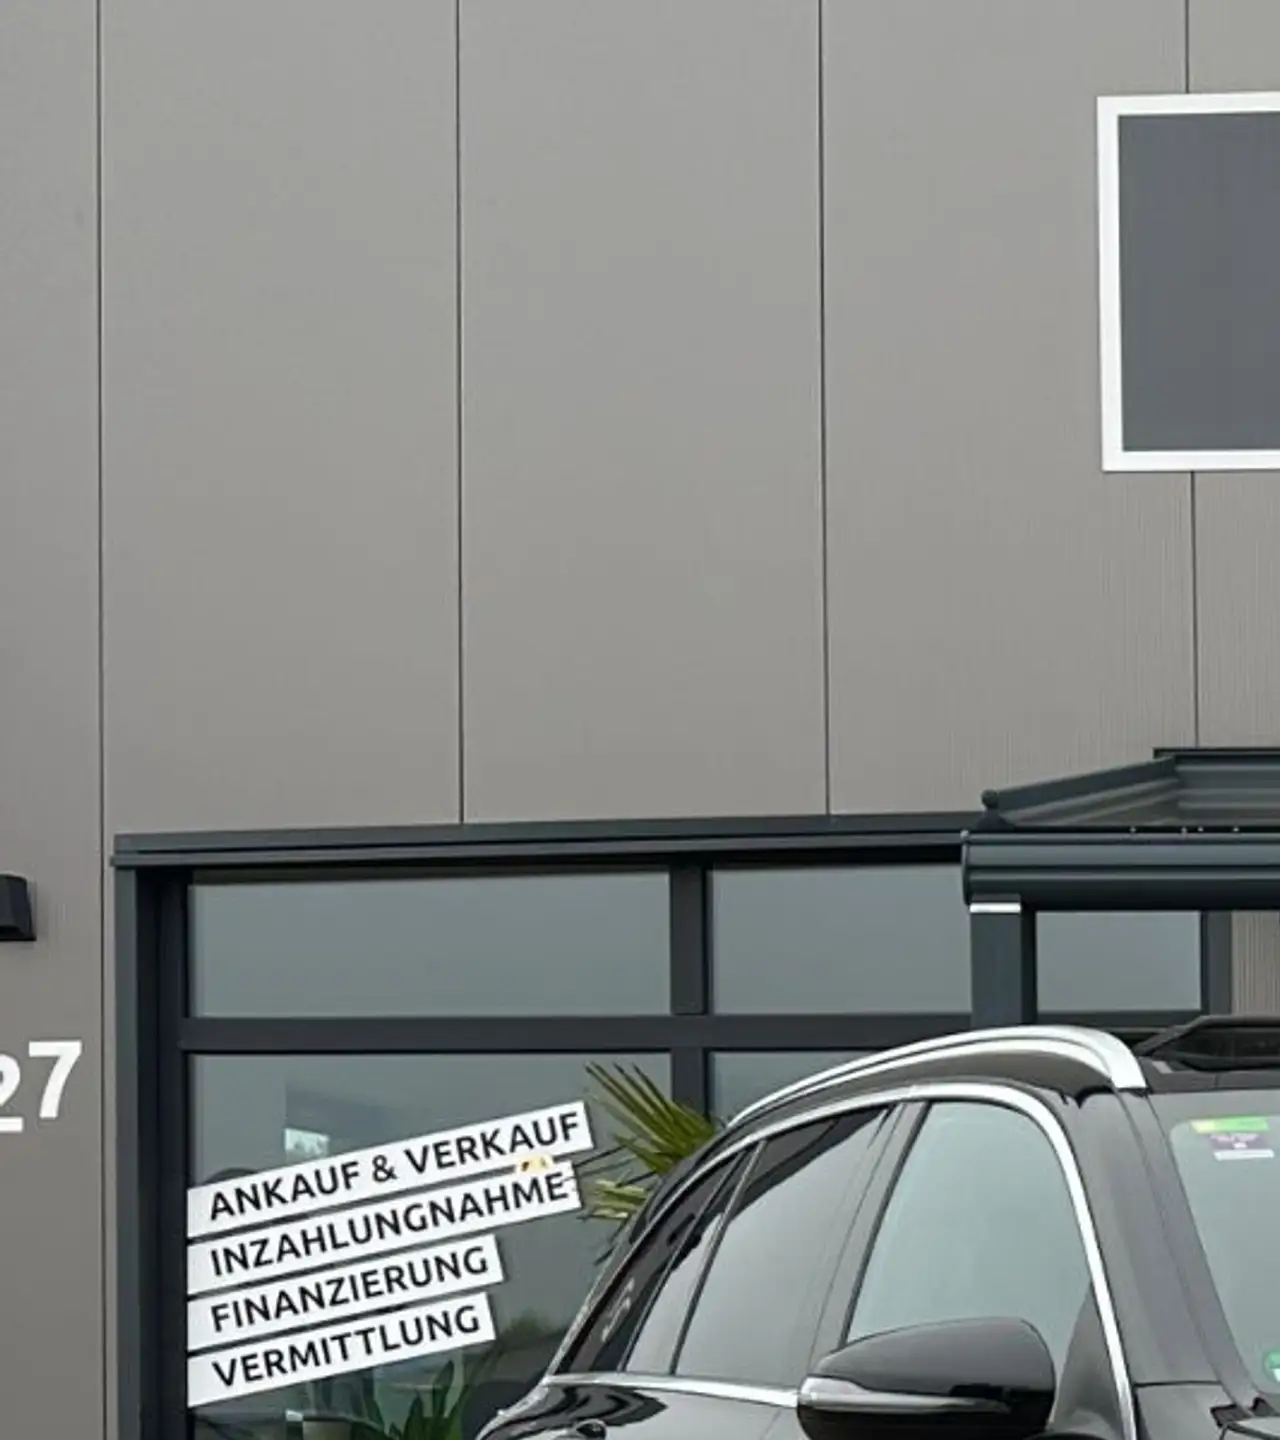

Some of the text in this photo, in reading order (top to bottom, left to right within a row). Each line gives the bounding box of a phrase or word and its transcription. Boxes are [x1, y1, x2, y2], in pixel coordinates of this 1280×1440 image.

[211, 1112, 580, 1221] ANKAUF & VERKAUF
[211, 1171, 570, 1277] INZAHLUNGNAHME
[211, 1246, 489, 1333] FINANZIERUNG
[212, 1305, 480, 1388] VERMITTLUNG
